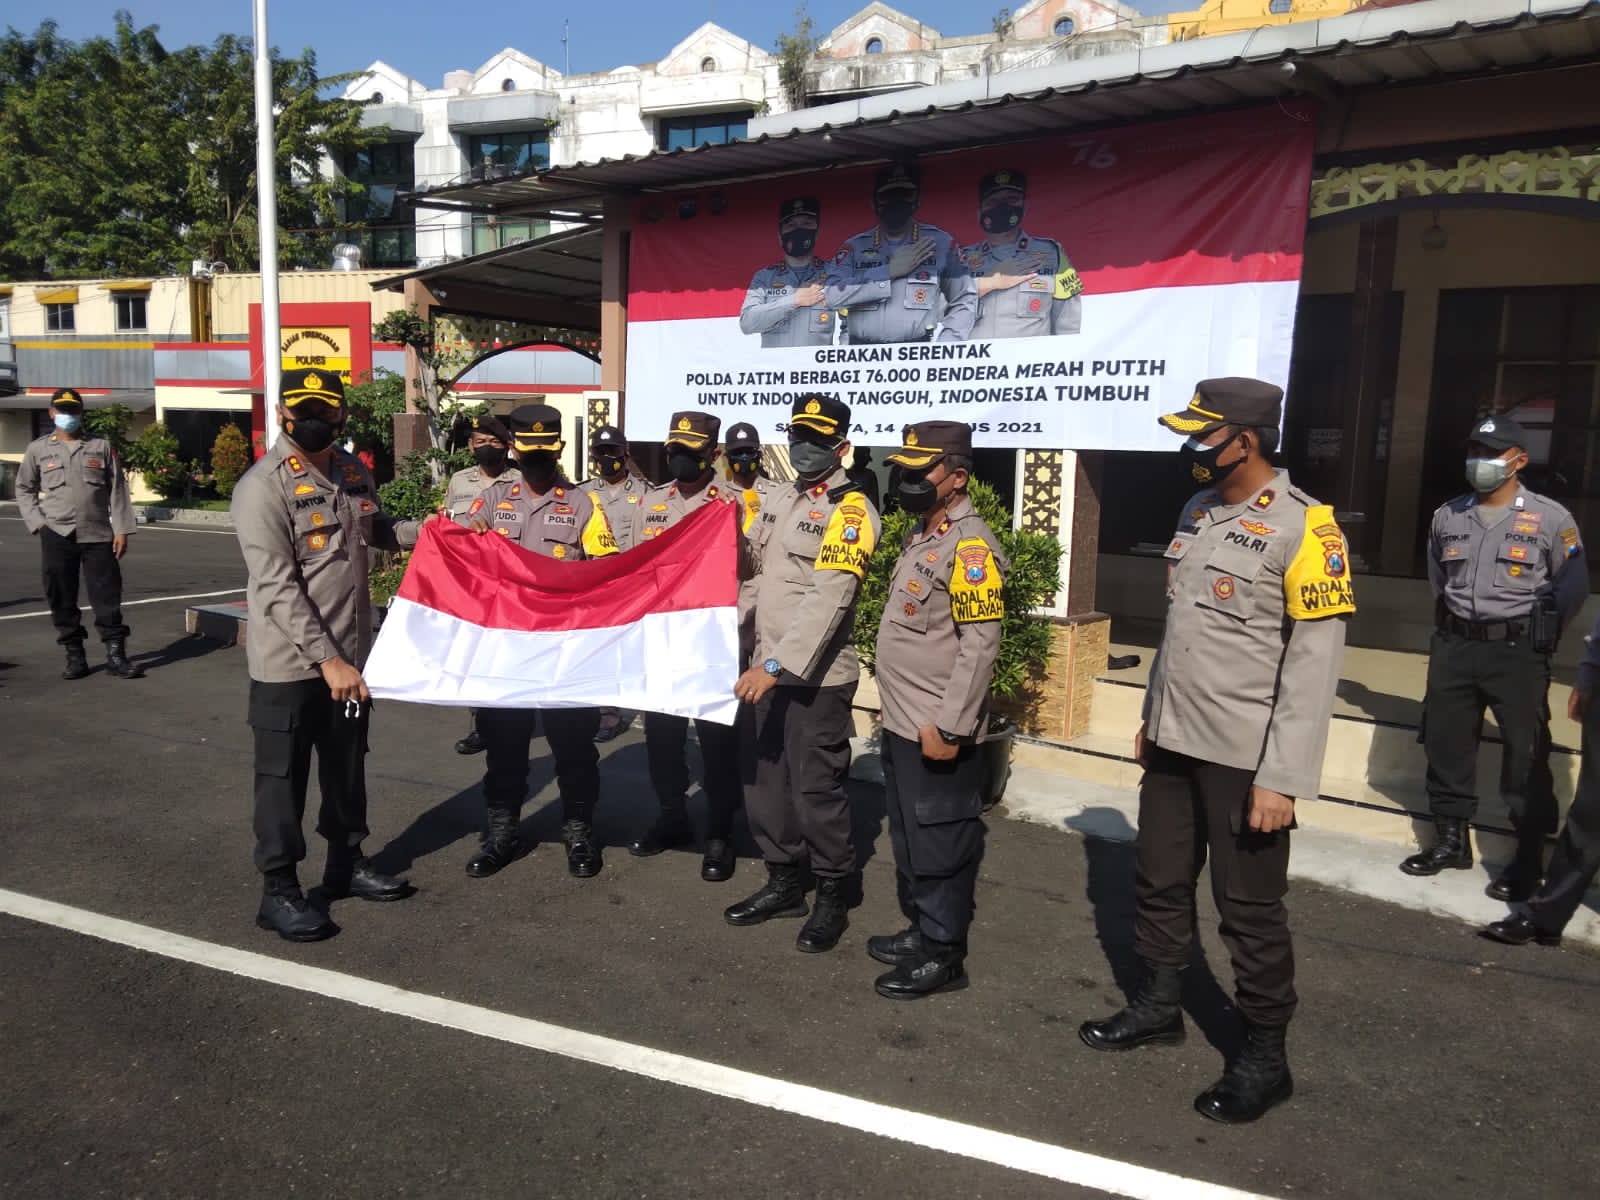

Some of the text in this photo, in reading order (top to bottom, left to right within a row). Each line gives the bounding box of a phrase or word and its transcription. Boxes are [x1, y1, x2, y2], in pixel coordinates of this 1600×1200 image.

[296, 355, 326, 366] POLRES
[815, 343, 992, 363] GERAKAN SERENTAK
[686, 359, 1166, 386] POLDA JATIM BERBAGI 76.000 BENDERA MERAH PUTIH
[698, 392, 748, 406] UNTUK
[848, 390, 933, 407] TANGGUH,
[939, 385, 1048, 404] INDONESIA
[1055, 384, 1150, 401] TUMBUH
[875, 423, 895, 433] 14
[997, 422, 1043, 433] 2021
[296, 495, 326, 510] ANTON
[494, 511, 517, 521] YUDO
[549, 515, 576, 526] POLRI
[797, 521, 824, 537] POLRI
[1224, 531, 1268, 552] POLRI
[1505, 532, 1538, 545] POLRI
[822, 545, 852, 556] PADAL
[1301, 580, 1344, 598] PADAL
[950, 589, 984, 606] PADAL
[956, 602, 1003, 619] WILAYAH
